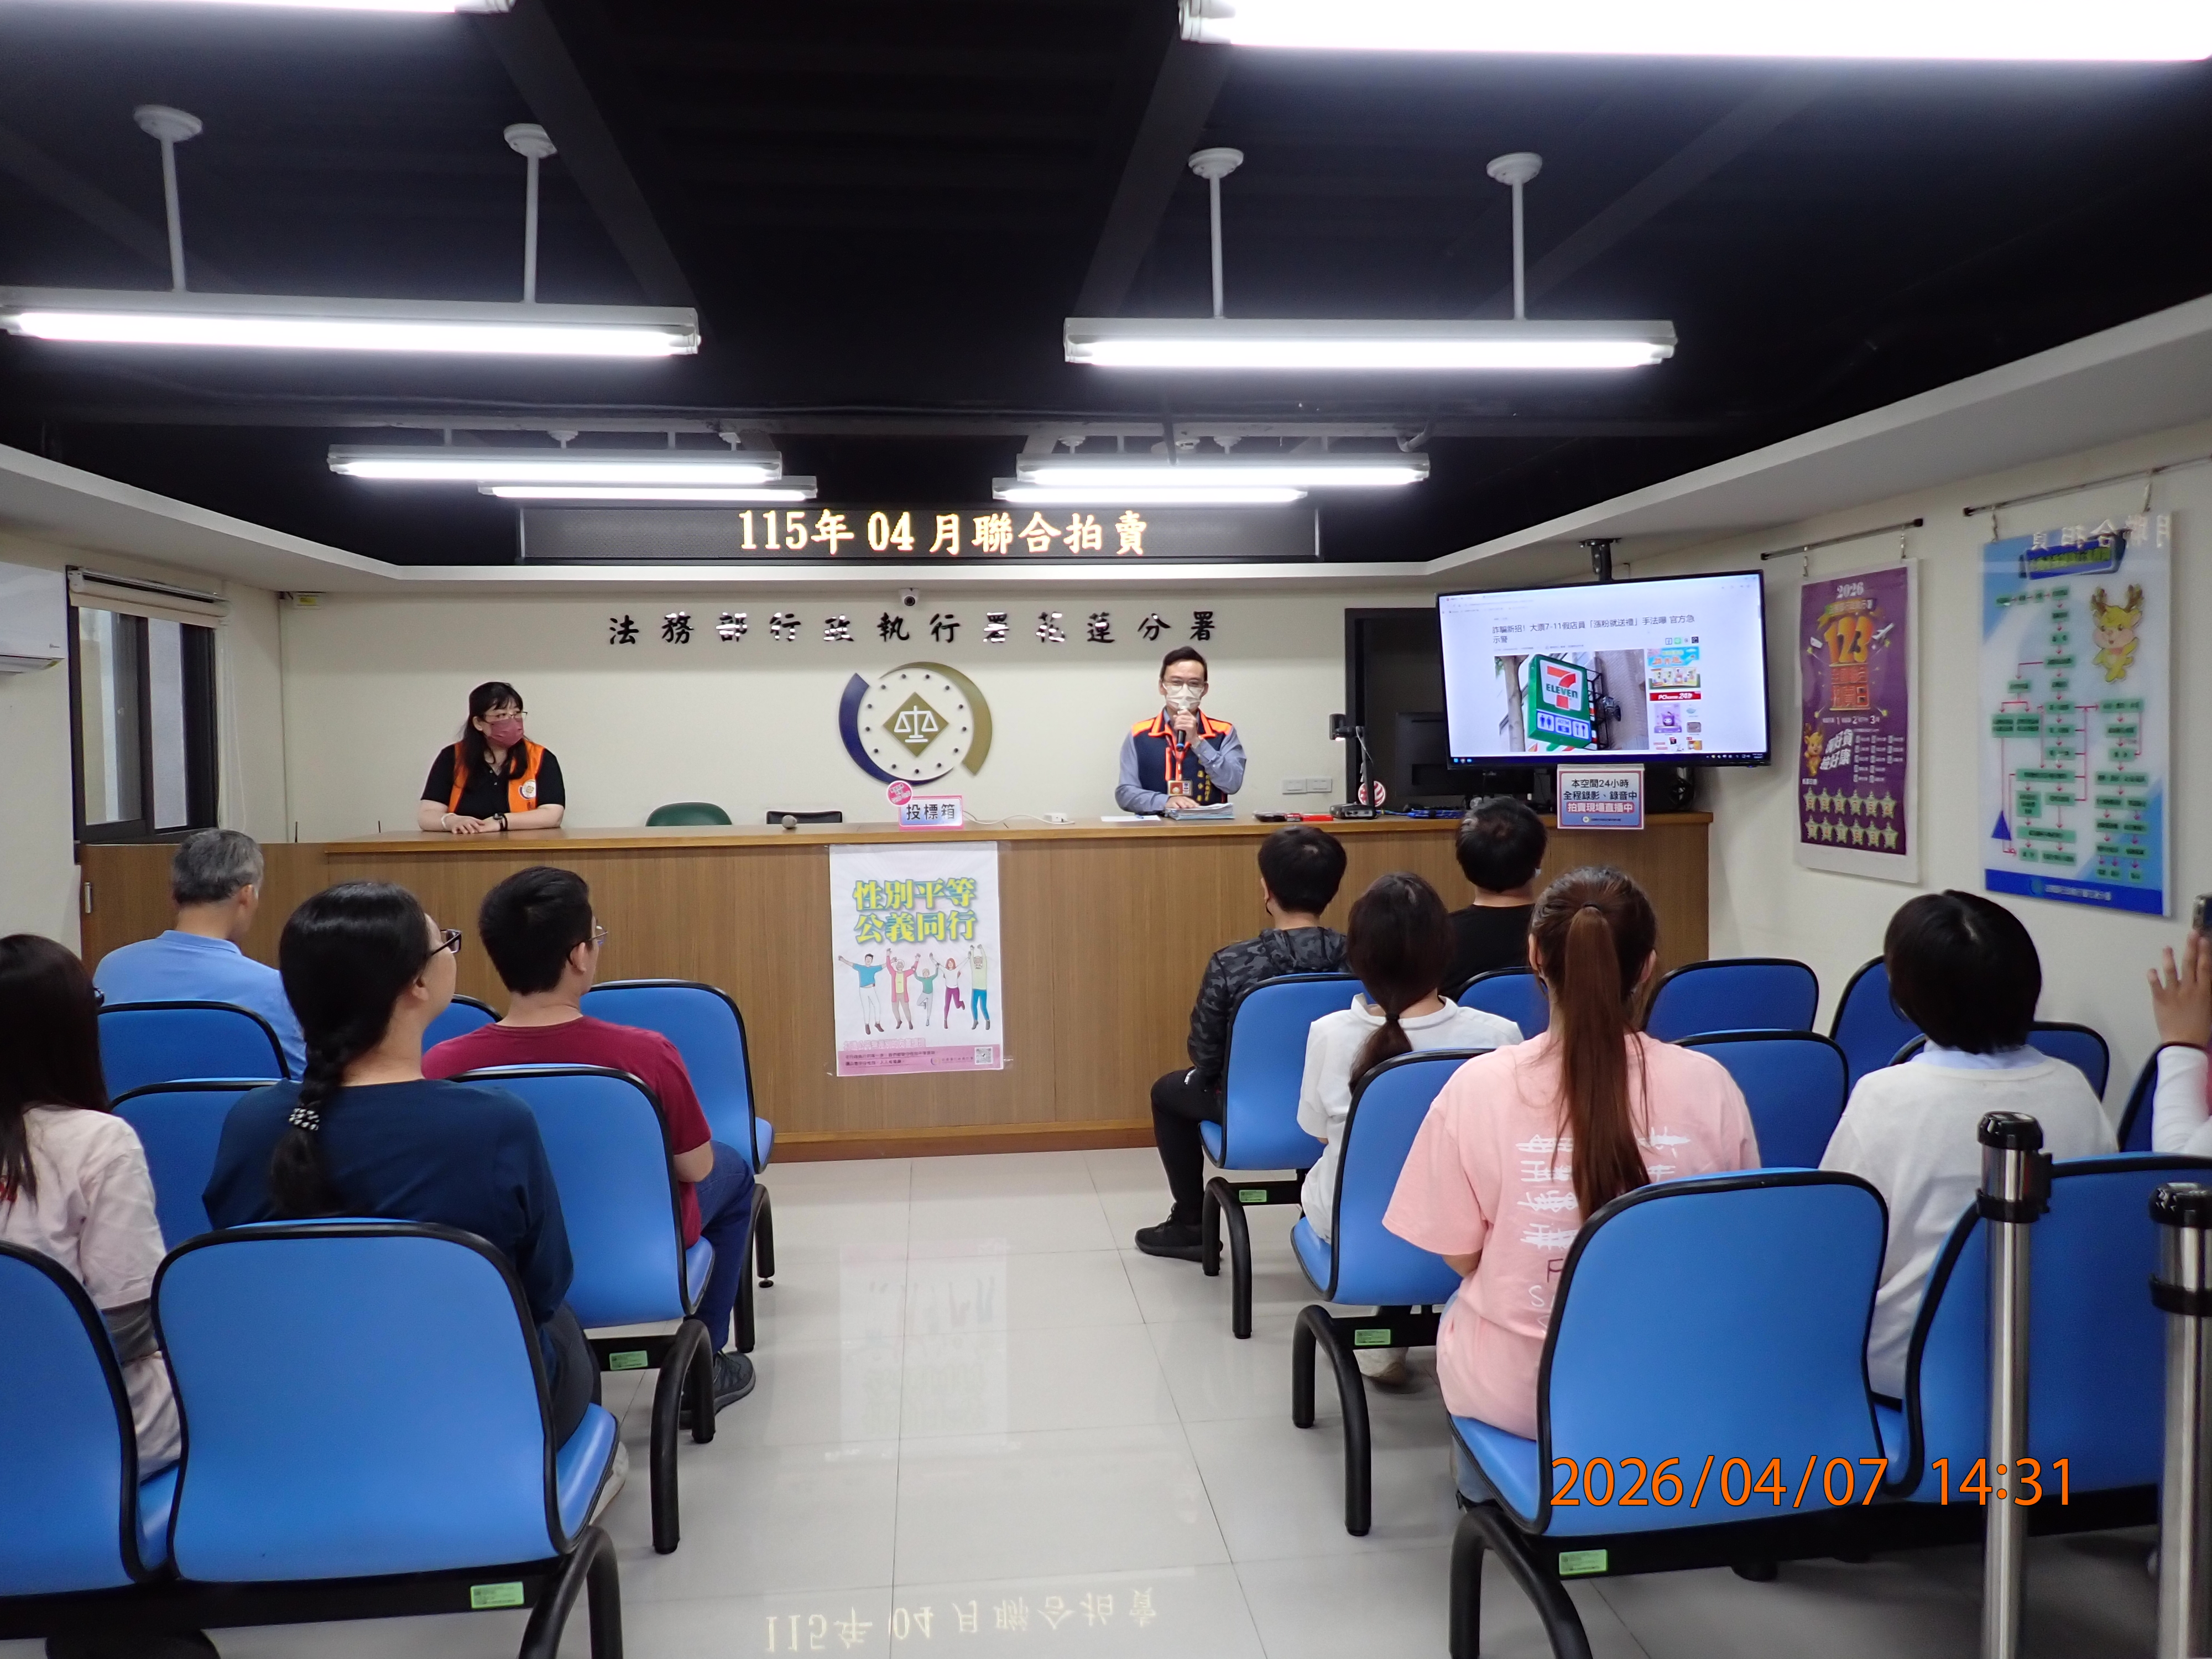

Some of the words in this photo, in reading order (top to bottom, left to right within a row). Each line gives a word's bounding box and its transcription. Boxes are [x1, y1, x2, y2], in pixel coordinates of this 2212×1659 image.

[738, 509, 855, 555] 115年
[867, 512, 915, 551] 04
[929, 509, 1148, 556] 月聯合拍賣
[1837, 582, 1864, 598] 2026
[1571, 779, 1629, 789] 本空間24小時
[906, 804, 955, 820] 投標箱
[1568, 802, 1632, 813] 拍賣現場直播中
[853, 877, 974, 911] 性別平等
[854, 911, 974, 942] 公義同行
